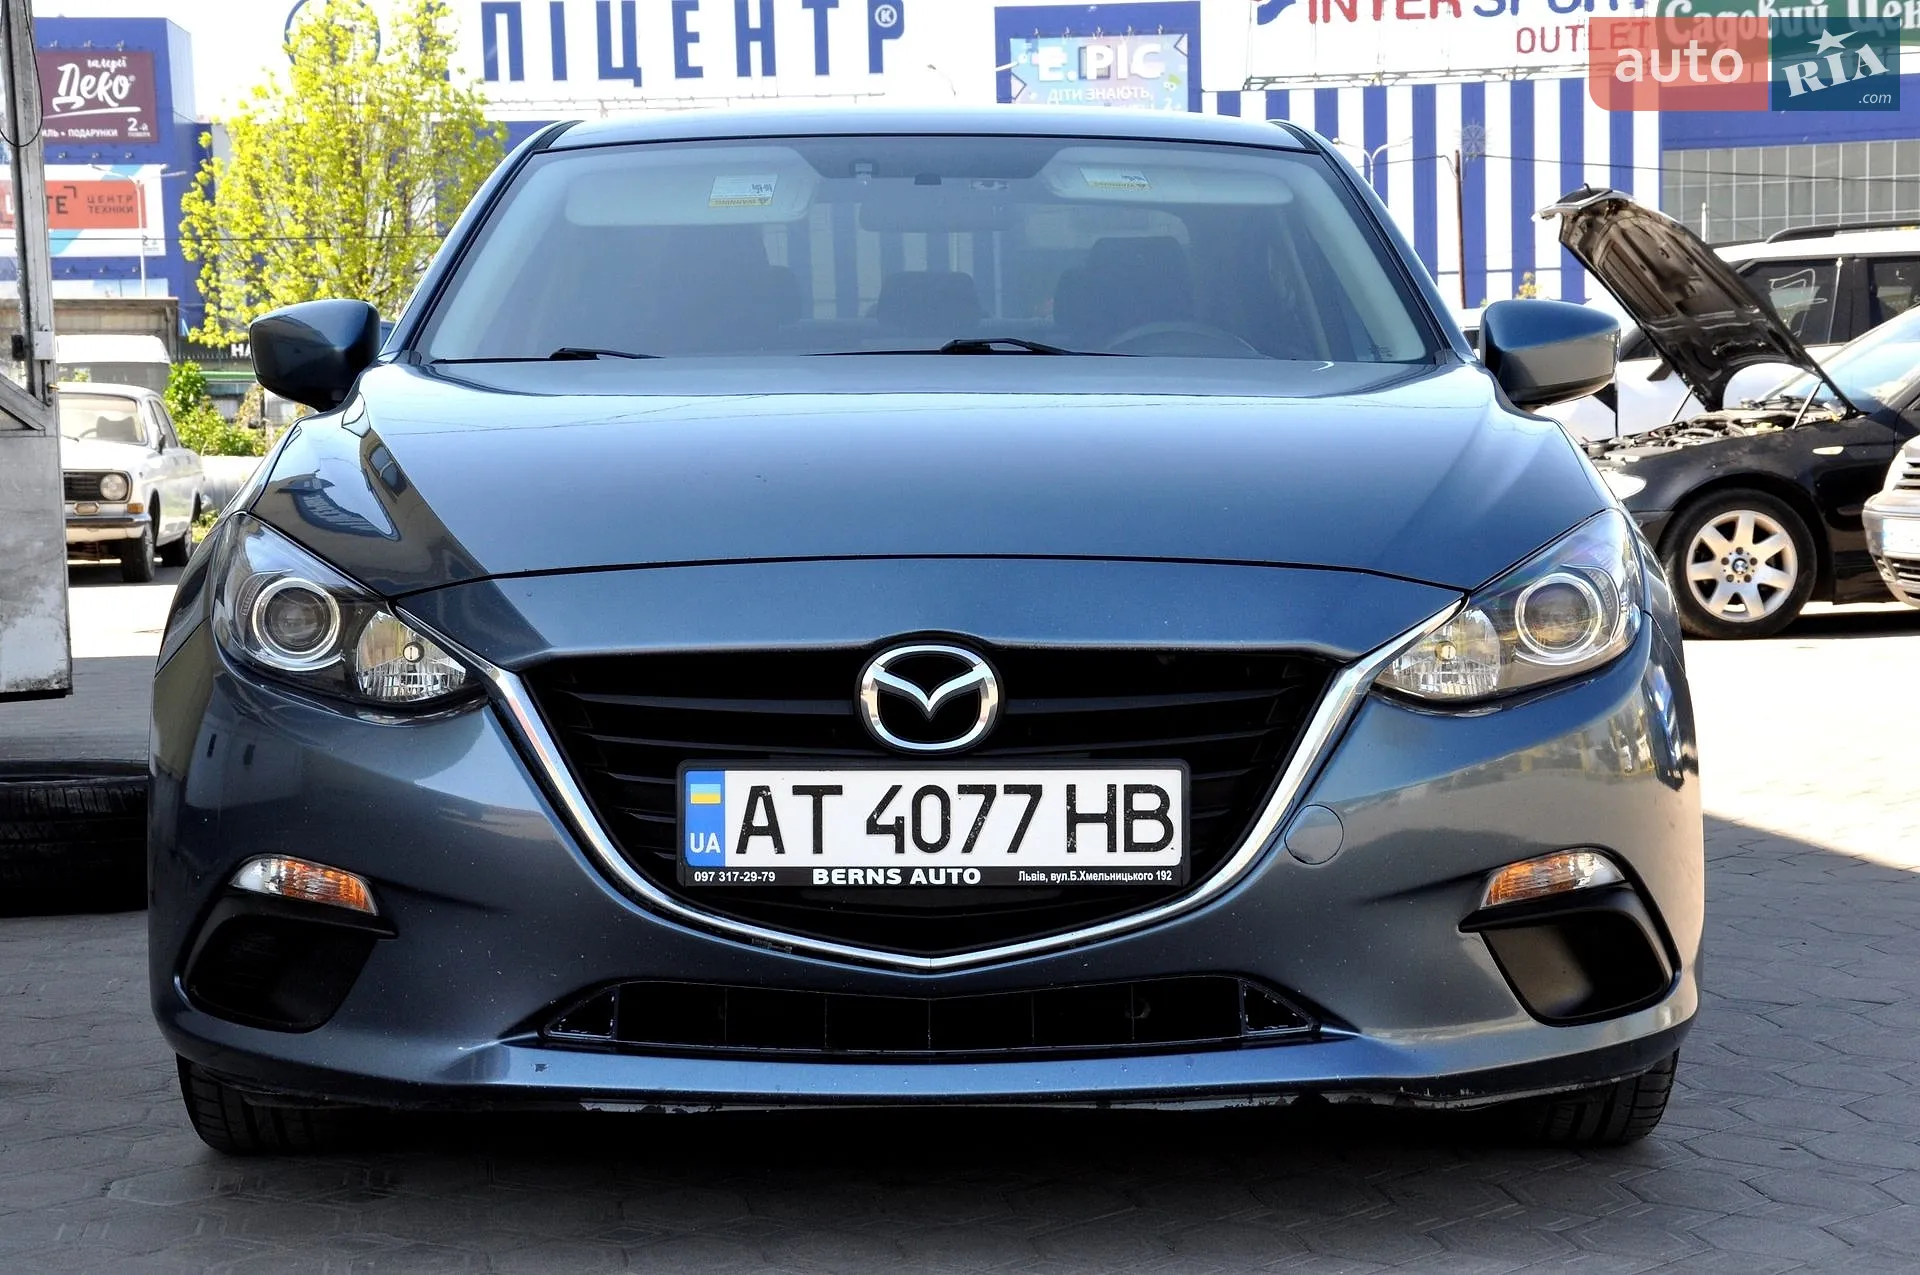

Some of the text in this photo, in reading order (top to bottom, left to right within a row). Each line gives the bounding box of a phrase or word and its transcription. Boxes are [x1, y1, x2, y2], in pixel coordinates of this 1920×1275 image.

[418, 0, 904, 87] ПІЦЕНТР
[1516, 20, 1651, 54] OUTLET
[1047, 89, 1083, 104] ДІТИ
[68, 128, 119, 138] ПОДАРУНКИ
[87, 194, 134, 204] ЦЕНТР
[89, 205, 134, 214] ТЕХНІКИ
[736, 783, 1175, 855] AT 4077 HB
[690, 832, 721, 853] UA
[694, 871, 776, 882] 097 317-29-79
[812, 868, 982, 885] BERNS AUTO
[1018, 870, 1048, 883] Львів,
[1156, 870, 1172, 881] 192
